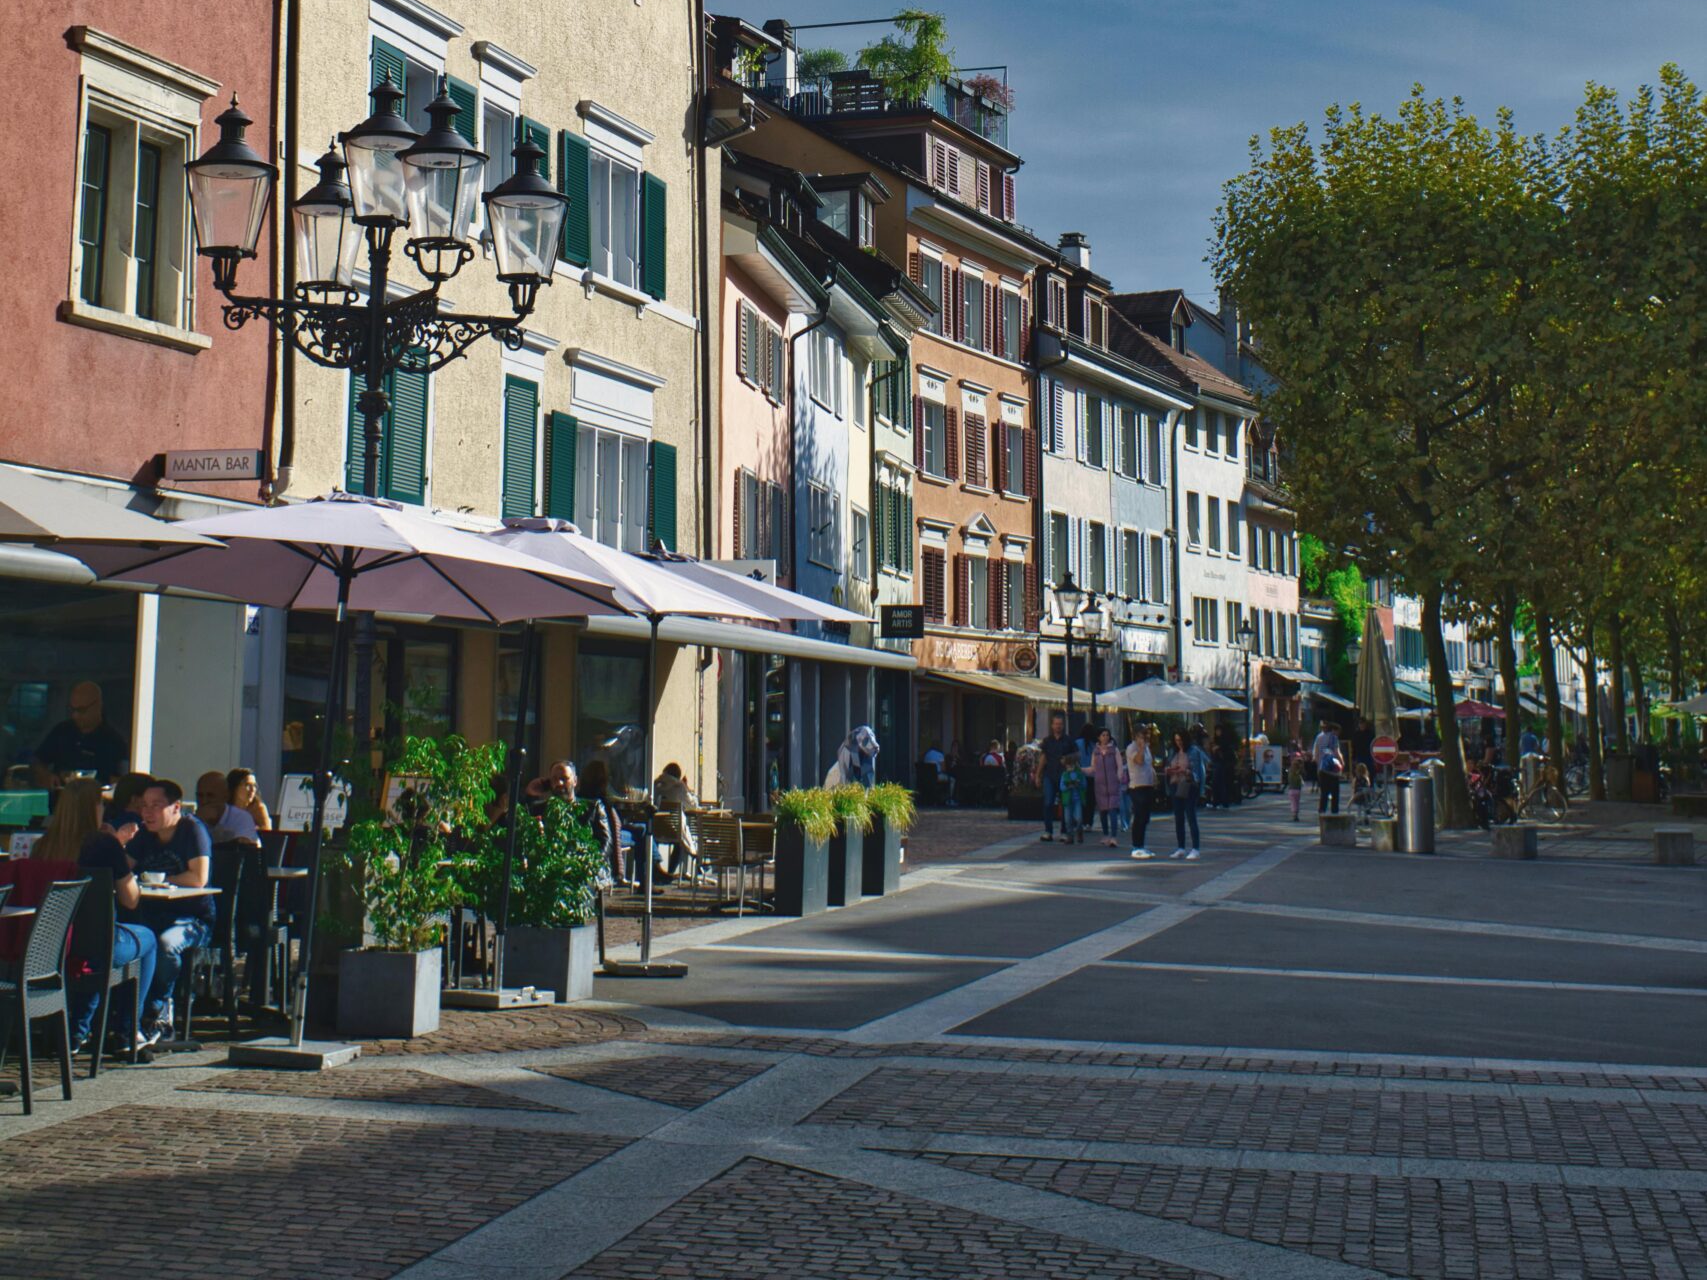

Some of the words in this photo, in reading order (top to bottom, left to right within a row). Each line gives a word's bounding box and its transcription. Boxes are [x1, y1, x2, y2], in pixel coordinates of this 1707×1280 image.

[172, 457, 221, 471] MANTA
[225, 456, 250, 470] BAR
[891, 609, 913, 619] AMOR
[891, 619, 913, 628] ARTIS
